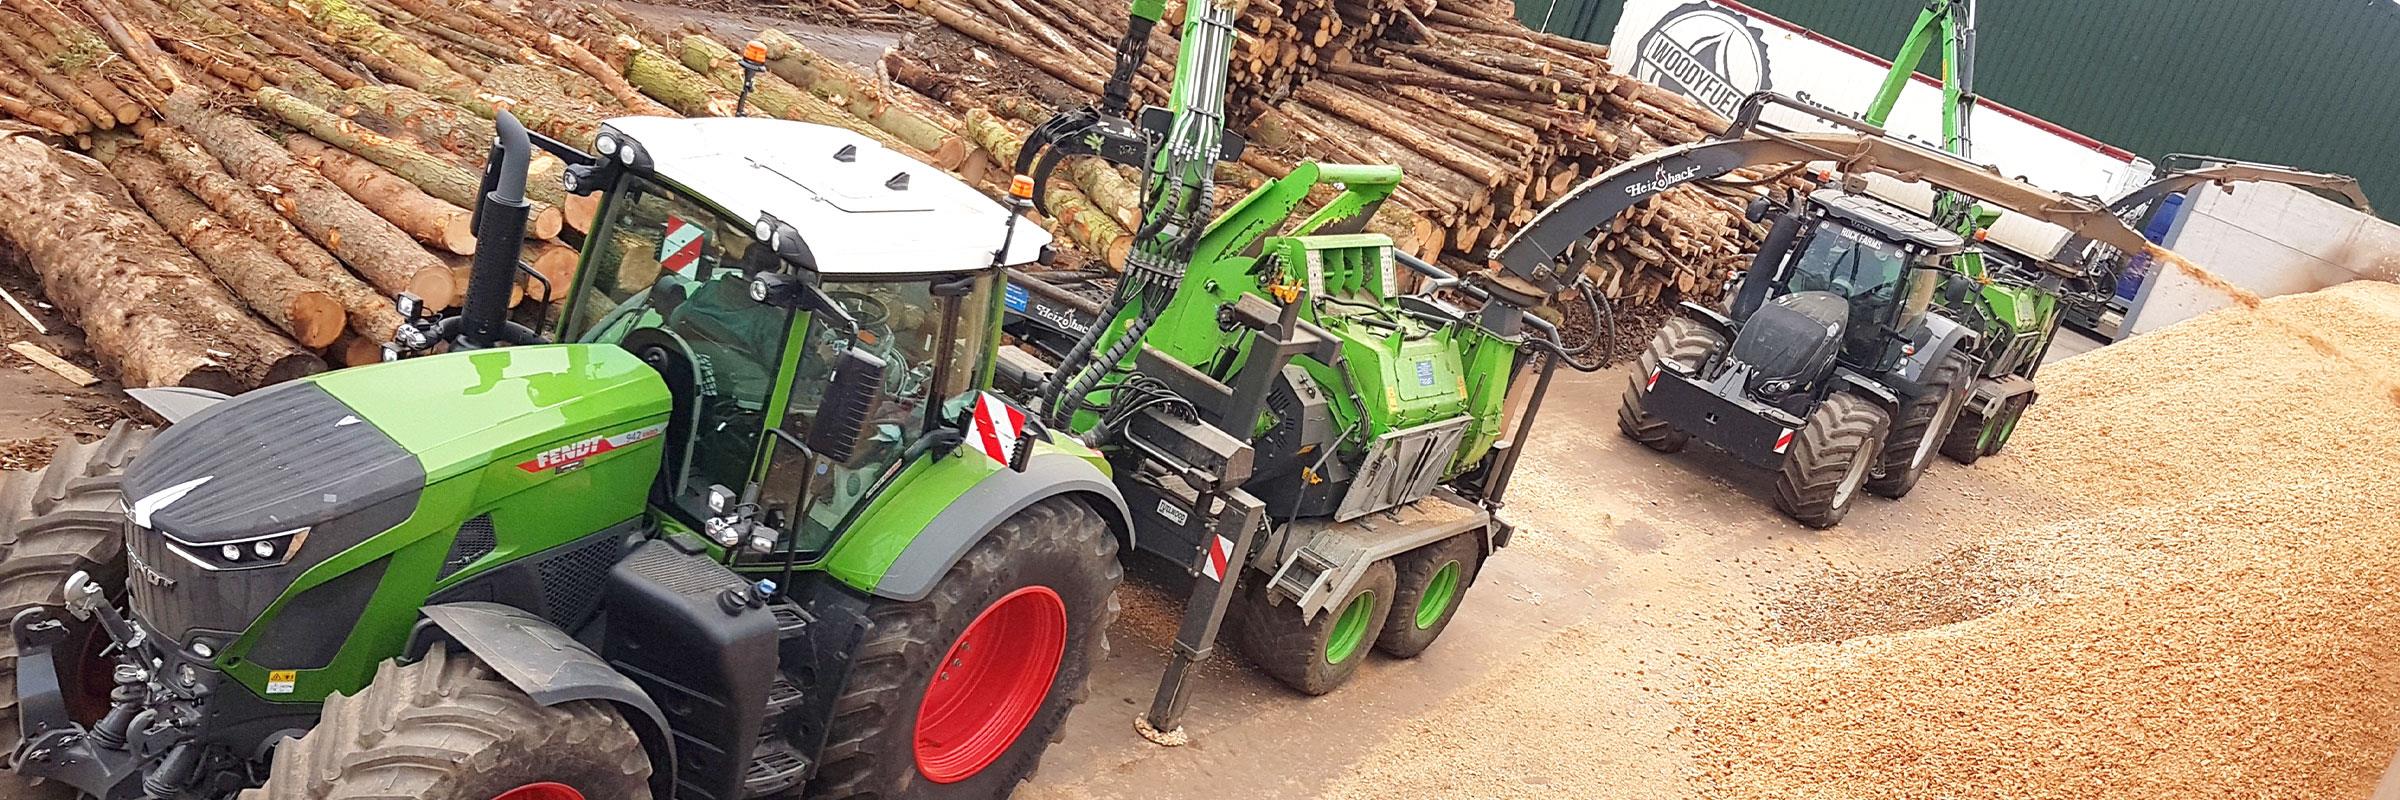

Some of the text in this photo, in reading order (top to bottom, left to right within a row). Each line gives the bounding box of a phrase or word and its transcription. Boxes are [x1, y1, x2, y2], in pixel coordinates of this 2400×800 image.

[1651, 38, 1742, 120] WOODYFUEL
[1840, 227, 1884, 250] ROCK FARMS
[1036, 304, 1090, 333] Heizohac
[537, 434, 604, 468] FENDT
